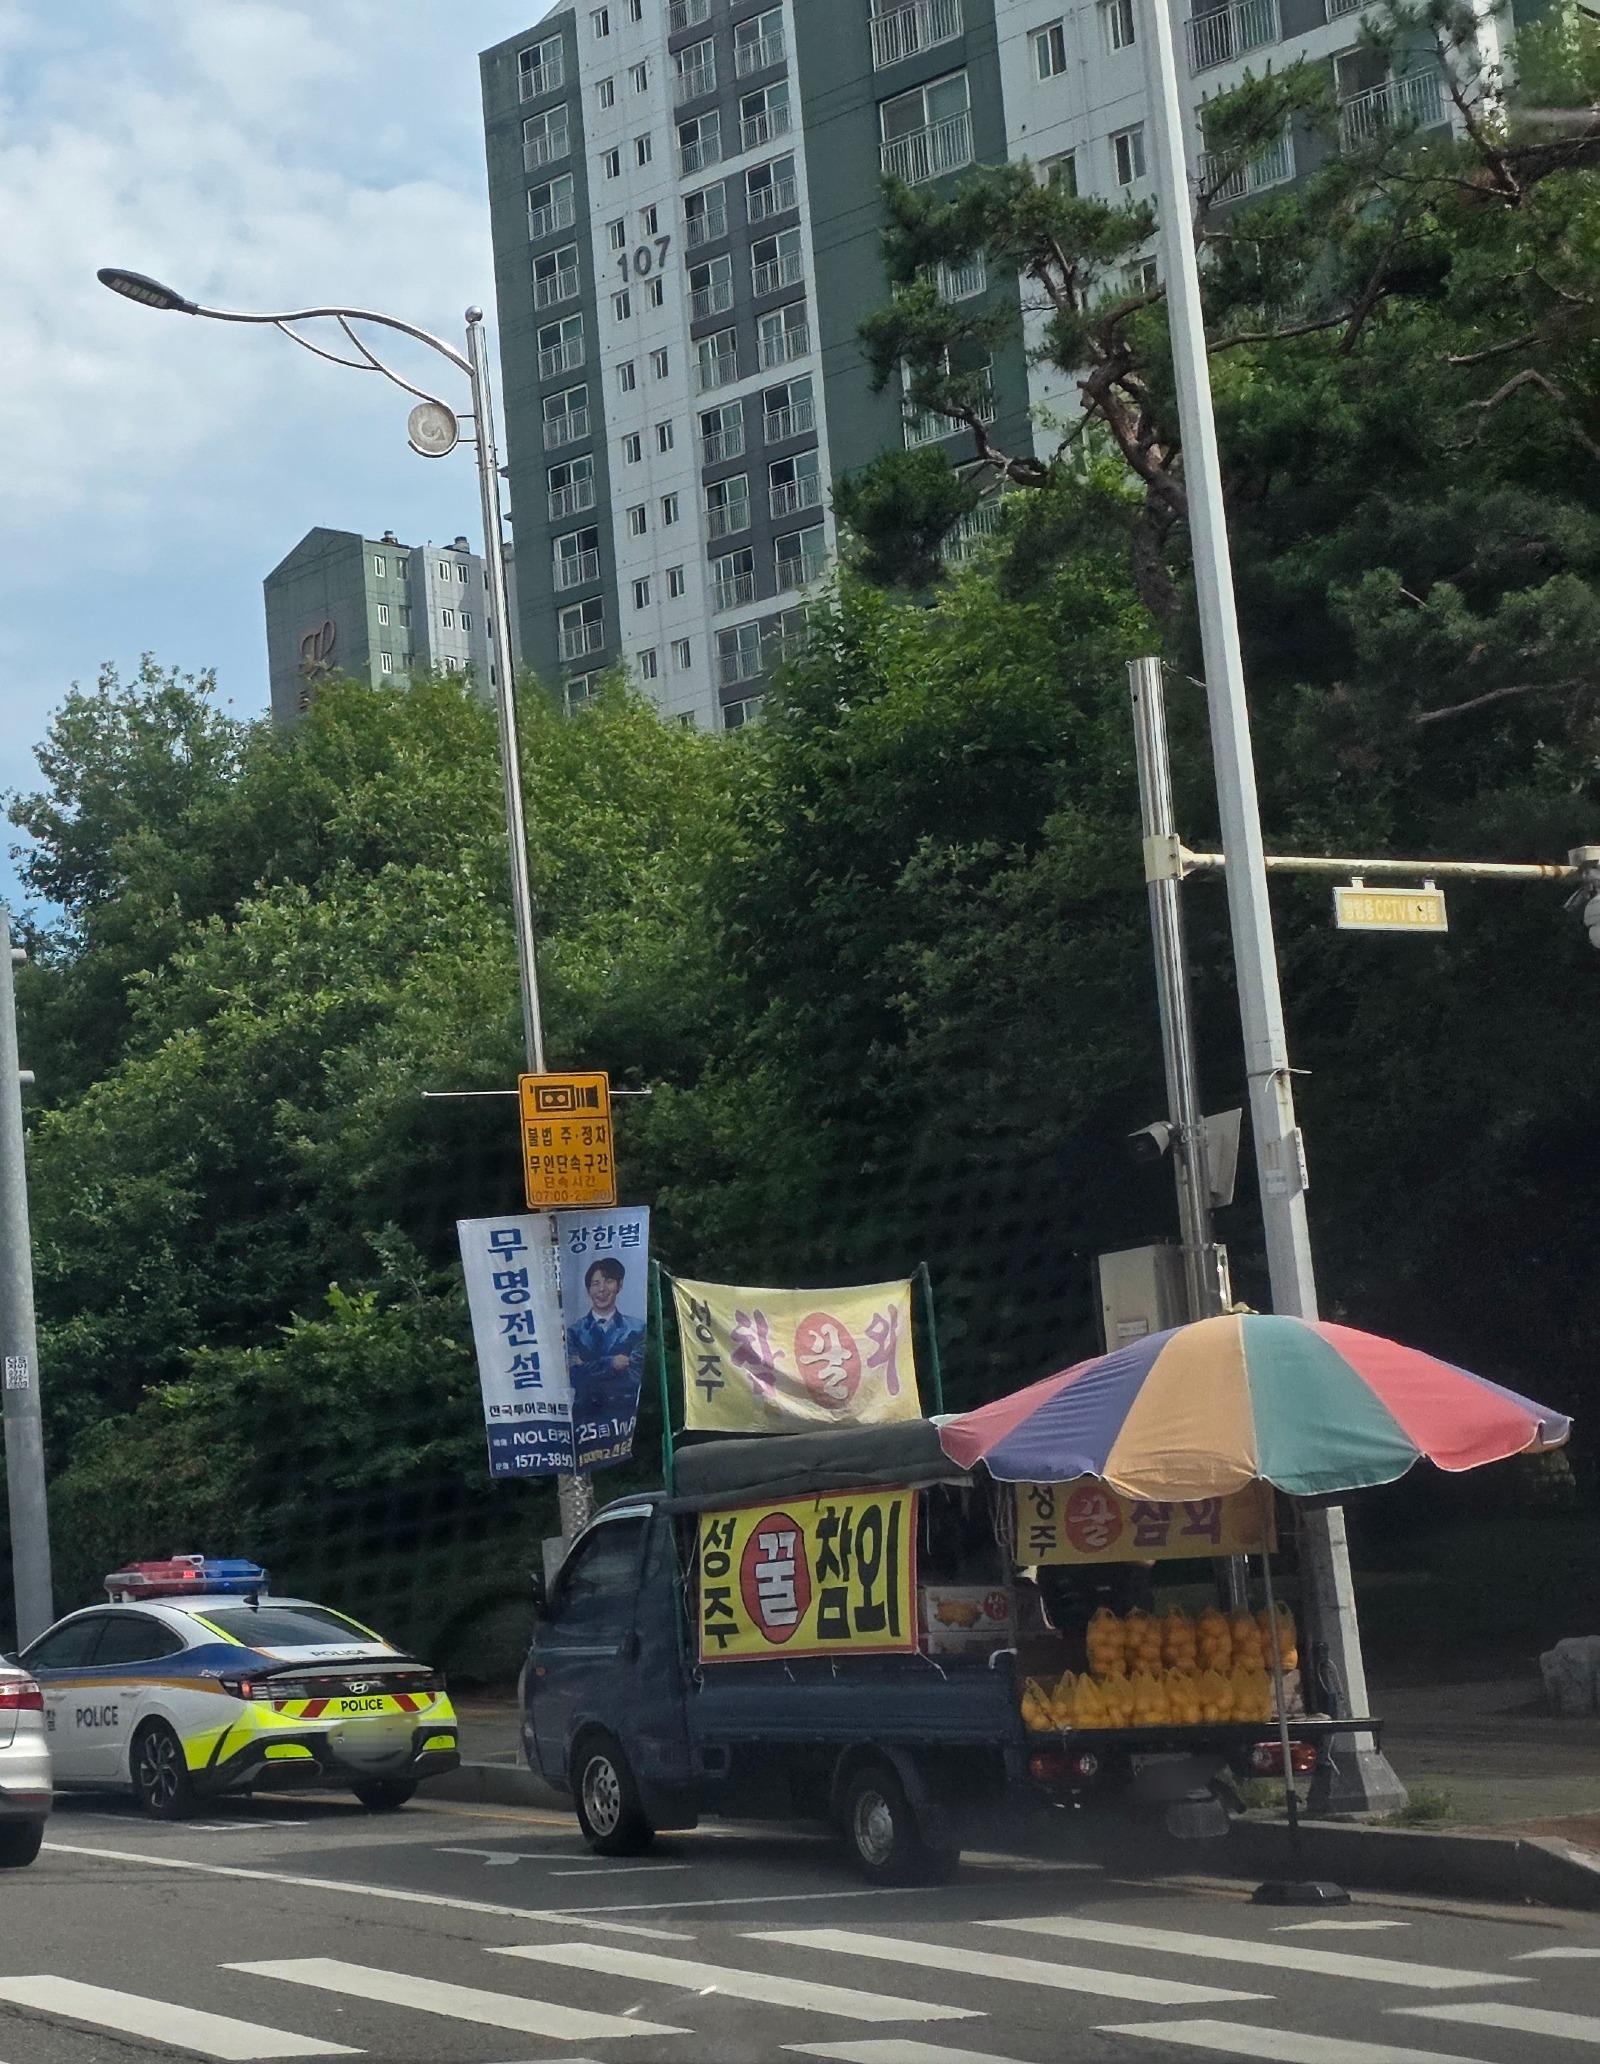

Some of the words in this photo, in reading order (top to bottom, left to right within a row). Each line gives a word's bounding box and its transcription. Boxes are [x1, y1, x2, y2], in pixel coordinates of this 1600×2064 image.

[617, 234, 671, 283] 107
[528, 1127, 552, 1147] 불법
[530, 1153, 608, 1175] 무인단속구간
[568, 1222, 641, 1254] 장한별
[487, 1228, 543, 1390] 무명전설
[690, 1297, 725, 1403] 성주
[1028, 1485, 1057, 1558] 성주
[702, 1517, 740, 1649] 성주
[311, 1649, 371, 1658] POLICE
[76, 1705, 119, 1728] POLICE
[341, 1698, 384, 1713] POLICE
